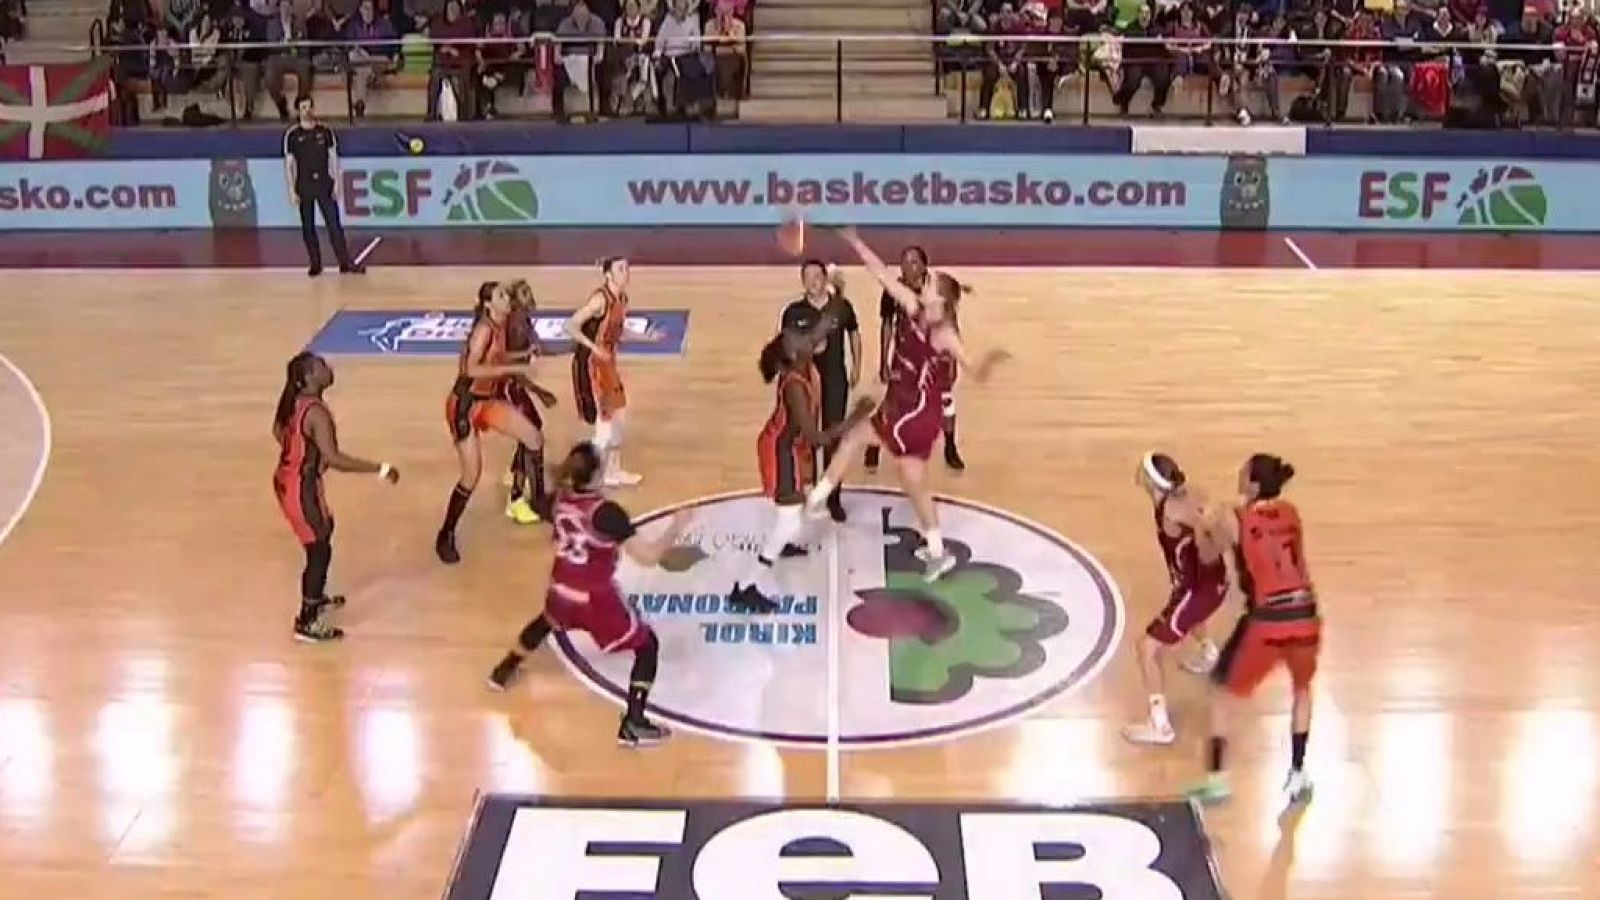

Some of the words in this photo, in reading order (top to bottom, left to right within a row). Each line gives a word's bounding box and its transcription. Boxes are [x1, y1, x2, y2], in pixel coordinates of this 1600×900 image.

[343, 168, 432, 218] ESF
[627, 171, 1187, 207] www.basketbasko.com
[1358, 170, 1450, 219] ESF
[699, 622, 818, 645] KIROL
